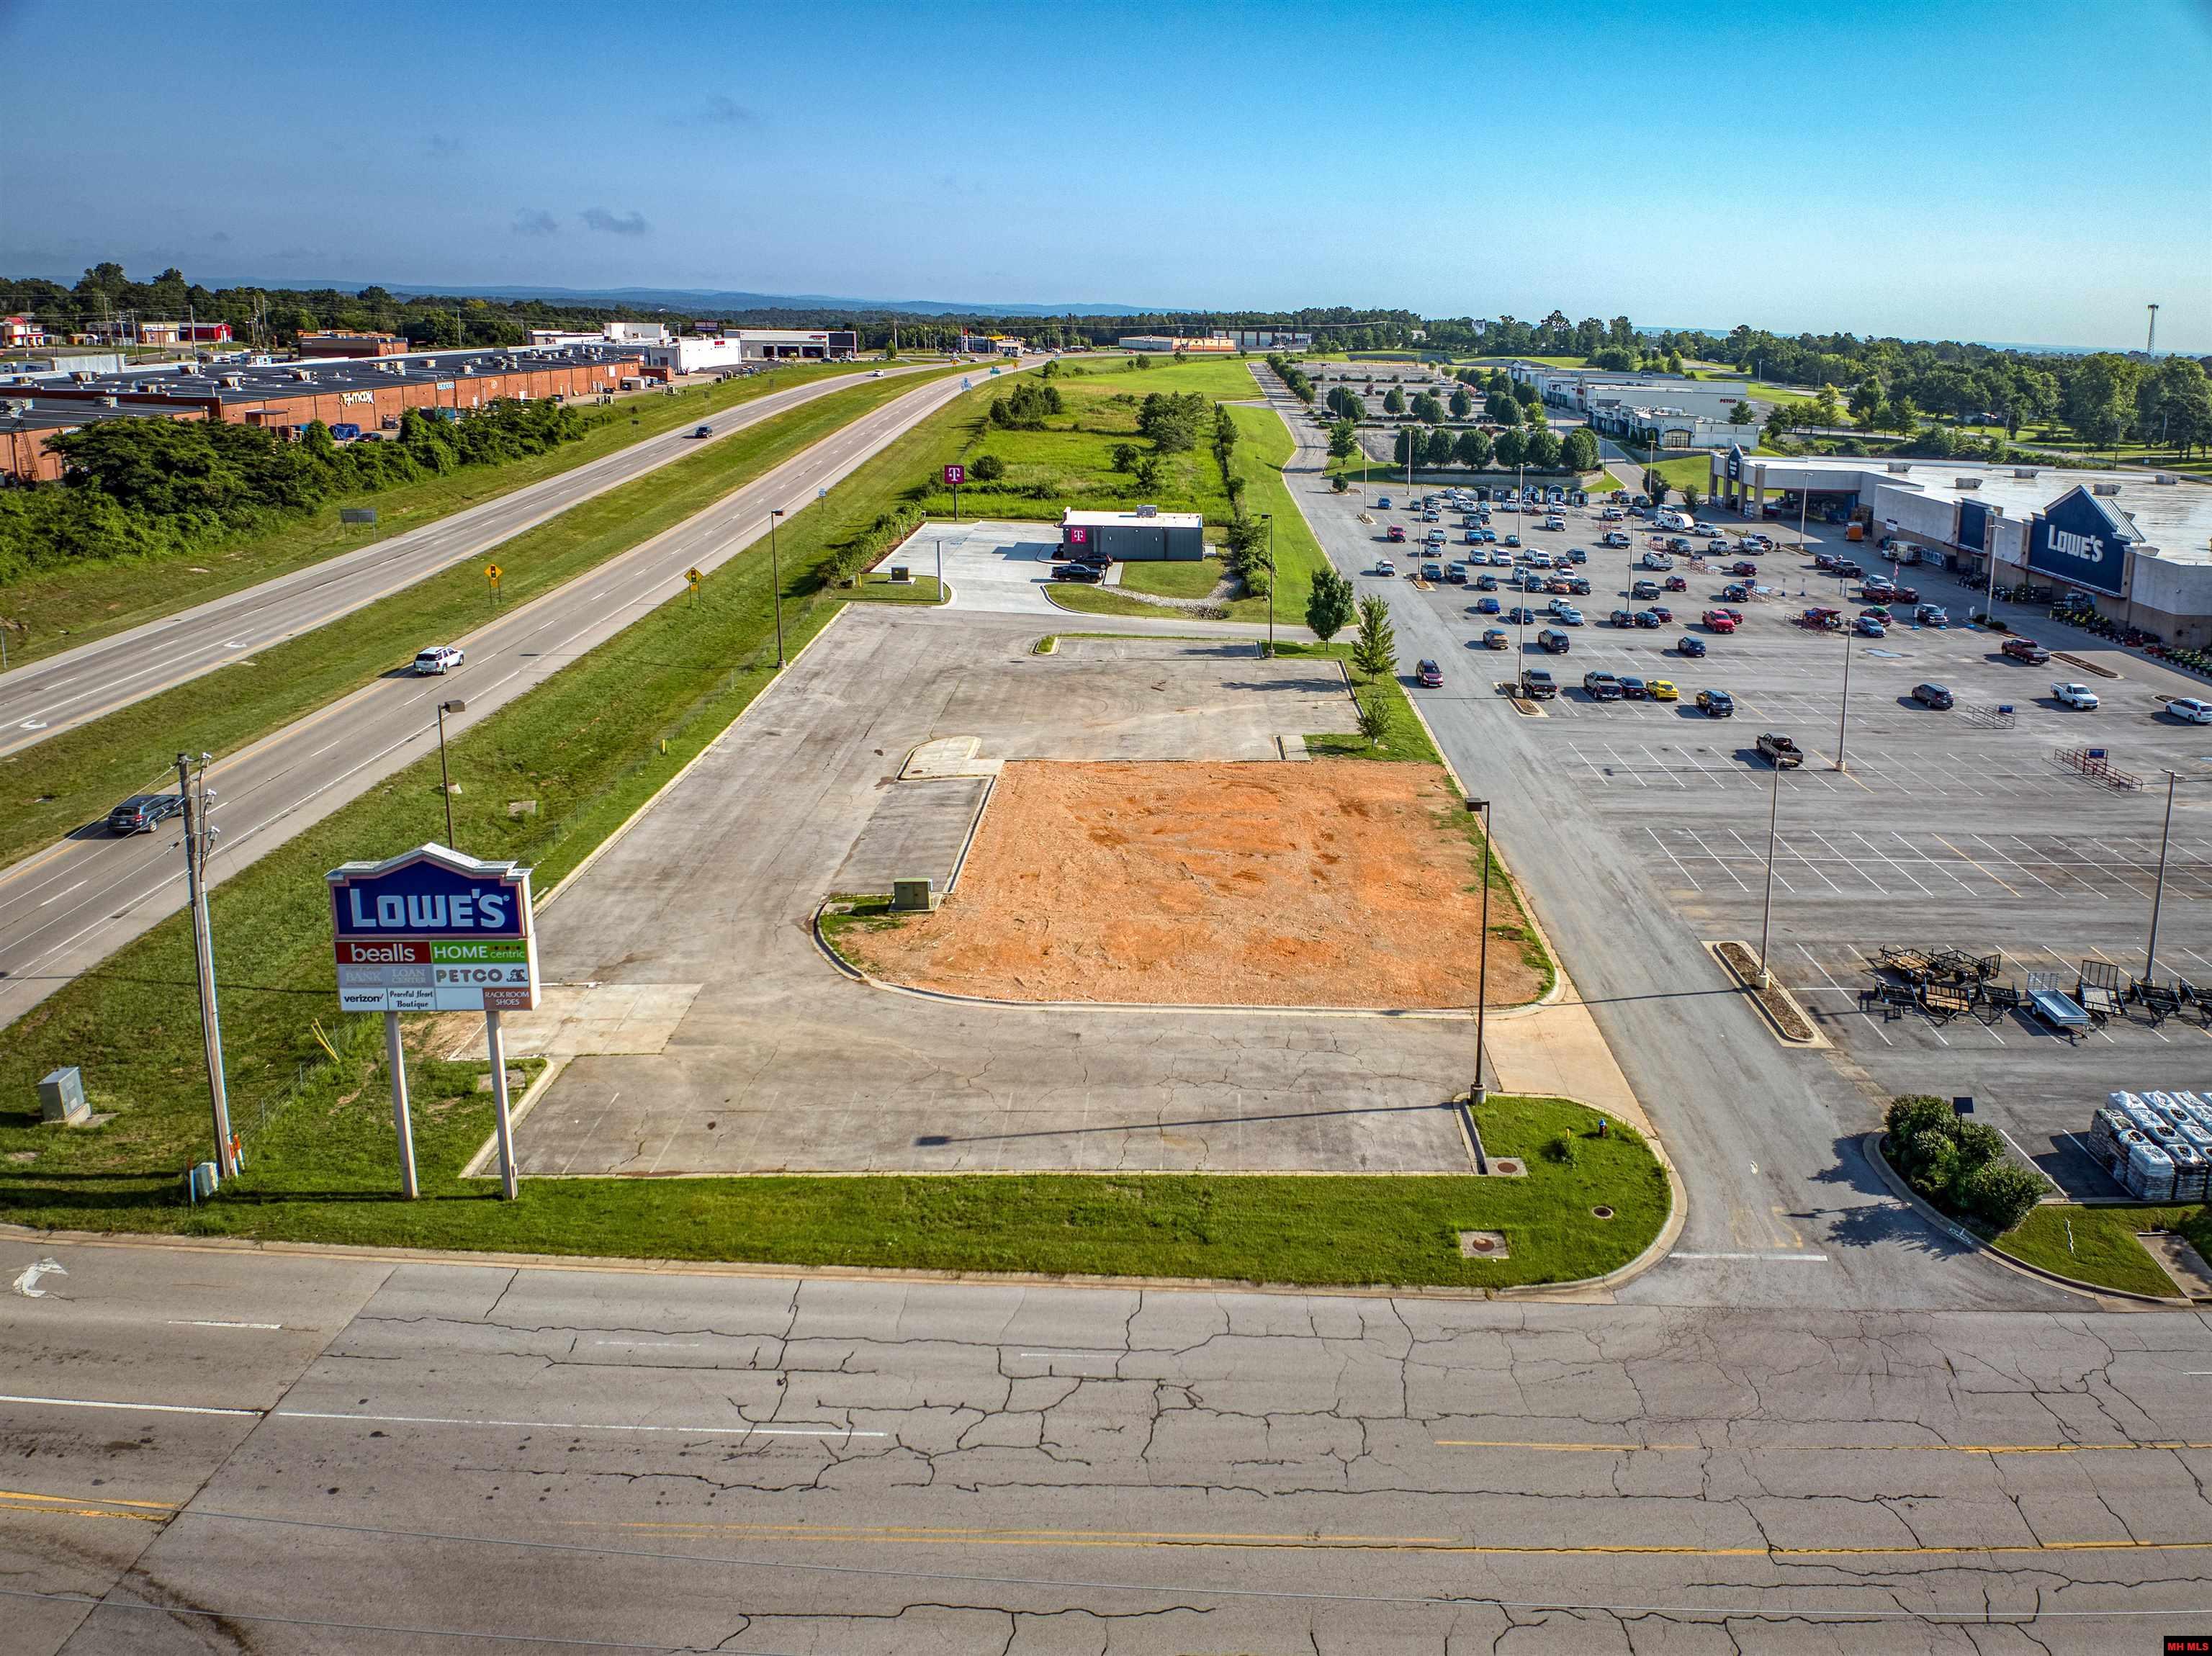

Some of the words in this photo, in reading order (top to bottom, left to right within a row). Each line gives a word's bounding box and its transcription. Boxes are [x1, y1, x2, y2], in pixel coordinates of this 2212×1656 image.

[2047, 524, 2103, 562] LOWE'S
[350, 888, 505, 928] LOWE'S
[351, 943, 415, 962] bealls
[433, 946, 488, 959] HOME
[490, 950, 525, 959] centric
[392, 968, 425, 977] LOAN
[436, 968, 503, 983] PETCO
[344, 994, 380, 1003] verizon
[416, 990, 433, 999] Heart
[396, 1000, 429, 1009] Boutique
